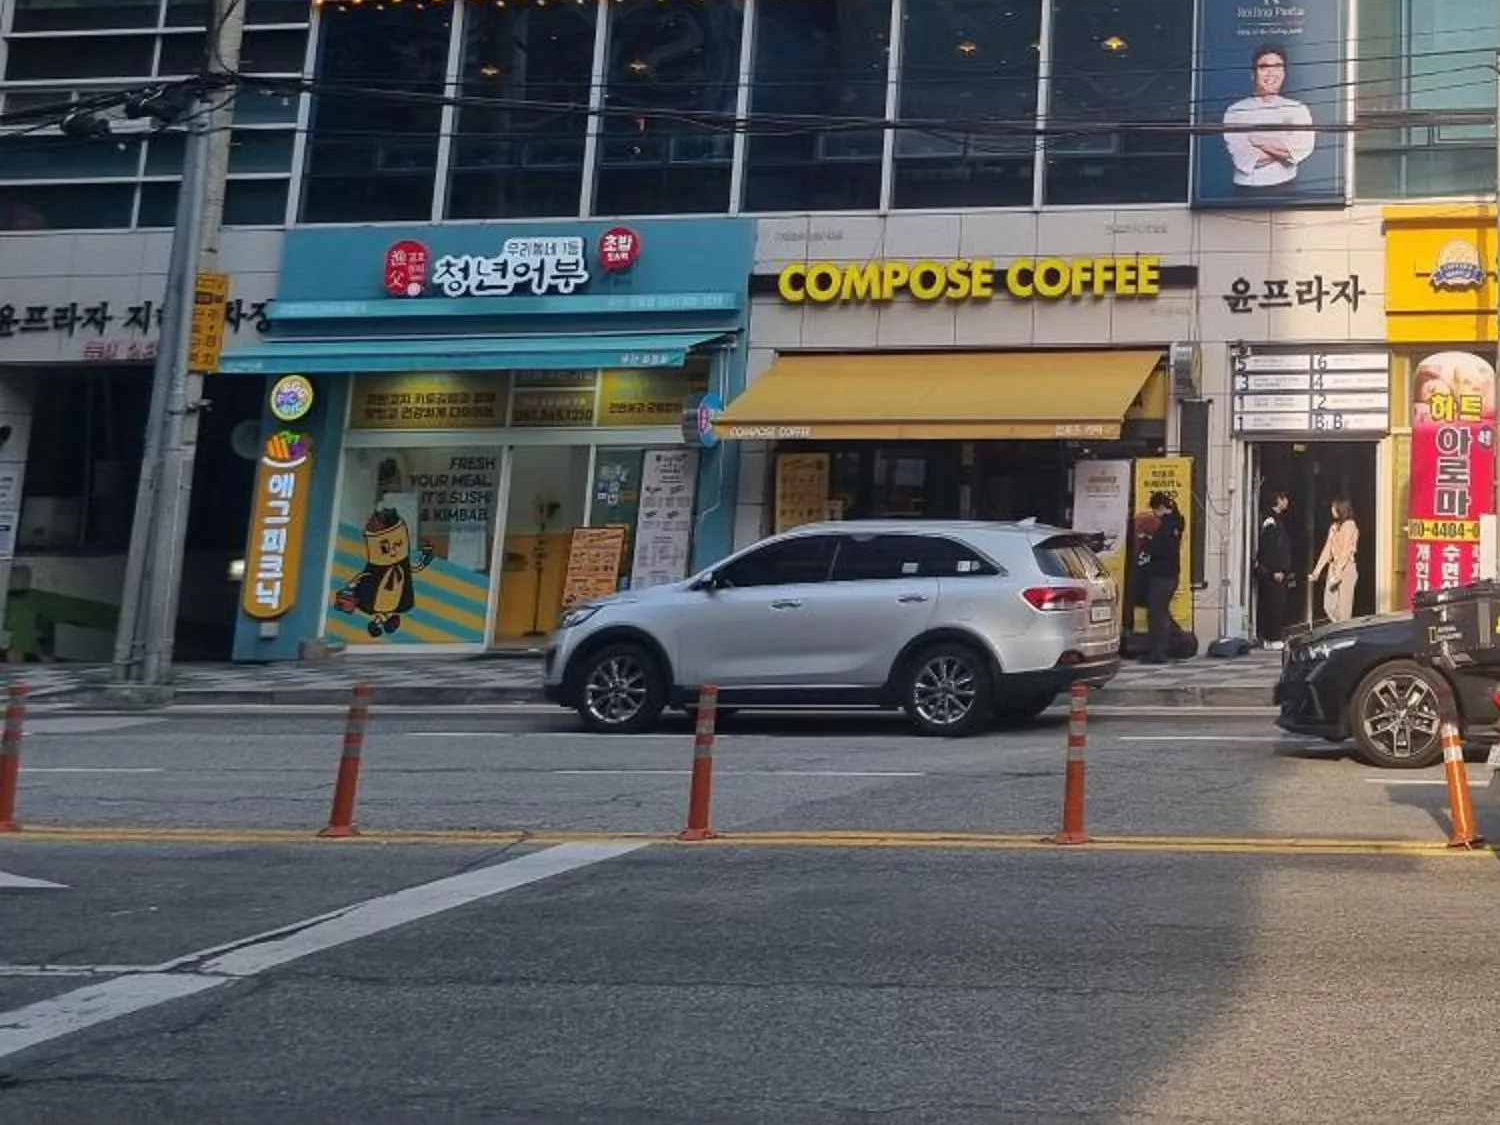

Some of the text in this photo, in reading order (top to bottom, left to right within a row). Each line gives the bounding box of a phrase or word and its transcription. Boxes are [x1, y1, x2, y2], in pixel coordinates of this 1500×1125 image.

[436, 257, 587, 294] 청년어부
[778, 255, 1162, 303] COMPOSE COFFEE
[1223, 274, 1367, 314] 윤프라자
[1434, 426, 1472, 518] 아로마
